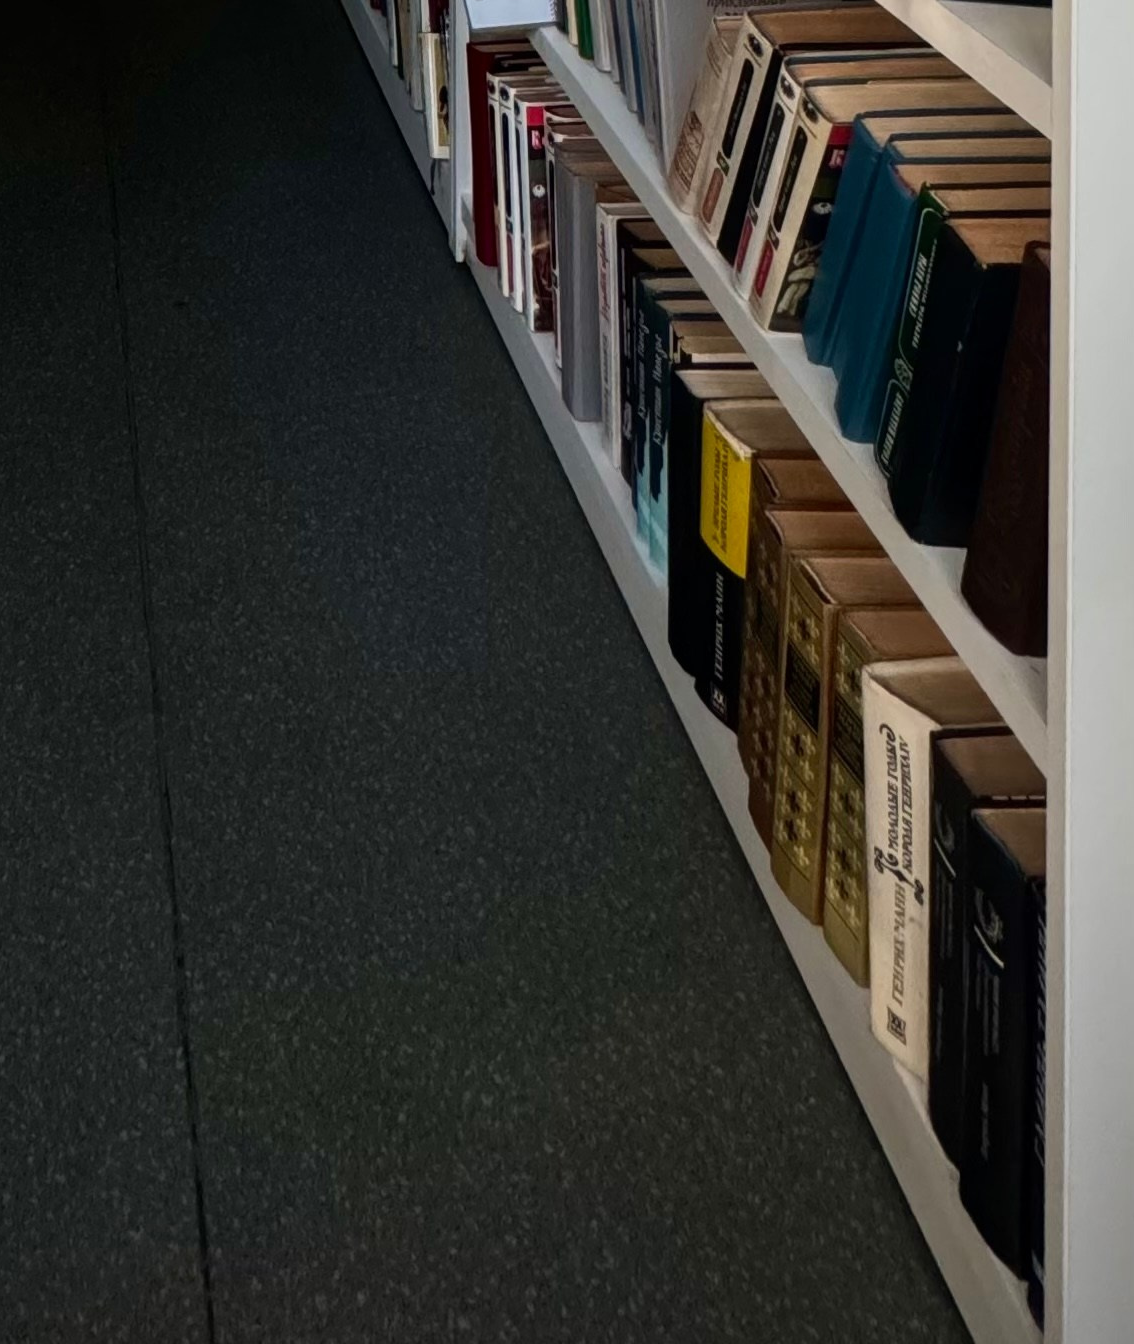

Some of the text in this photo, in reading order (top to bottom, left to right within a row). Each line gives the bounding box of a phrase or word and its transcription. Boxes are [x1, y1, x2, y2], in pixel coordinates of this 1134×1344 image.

[713, 571, 726, 680] ГЕНРИХ МАНН
[880, 723, 899, 852] МОЛОДЫЕ ГОДЫ
[900, 758, 912, 820] ГЕНРИХА
[901, 820, 914, 875] КОРОЛЯ
[891, 883, 907, 1008] ГЕНРИХ МАНН
